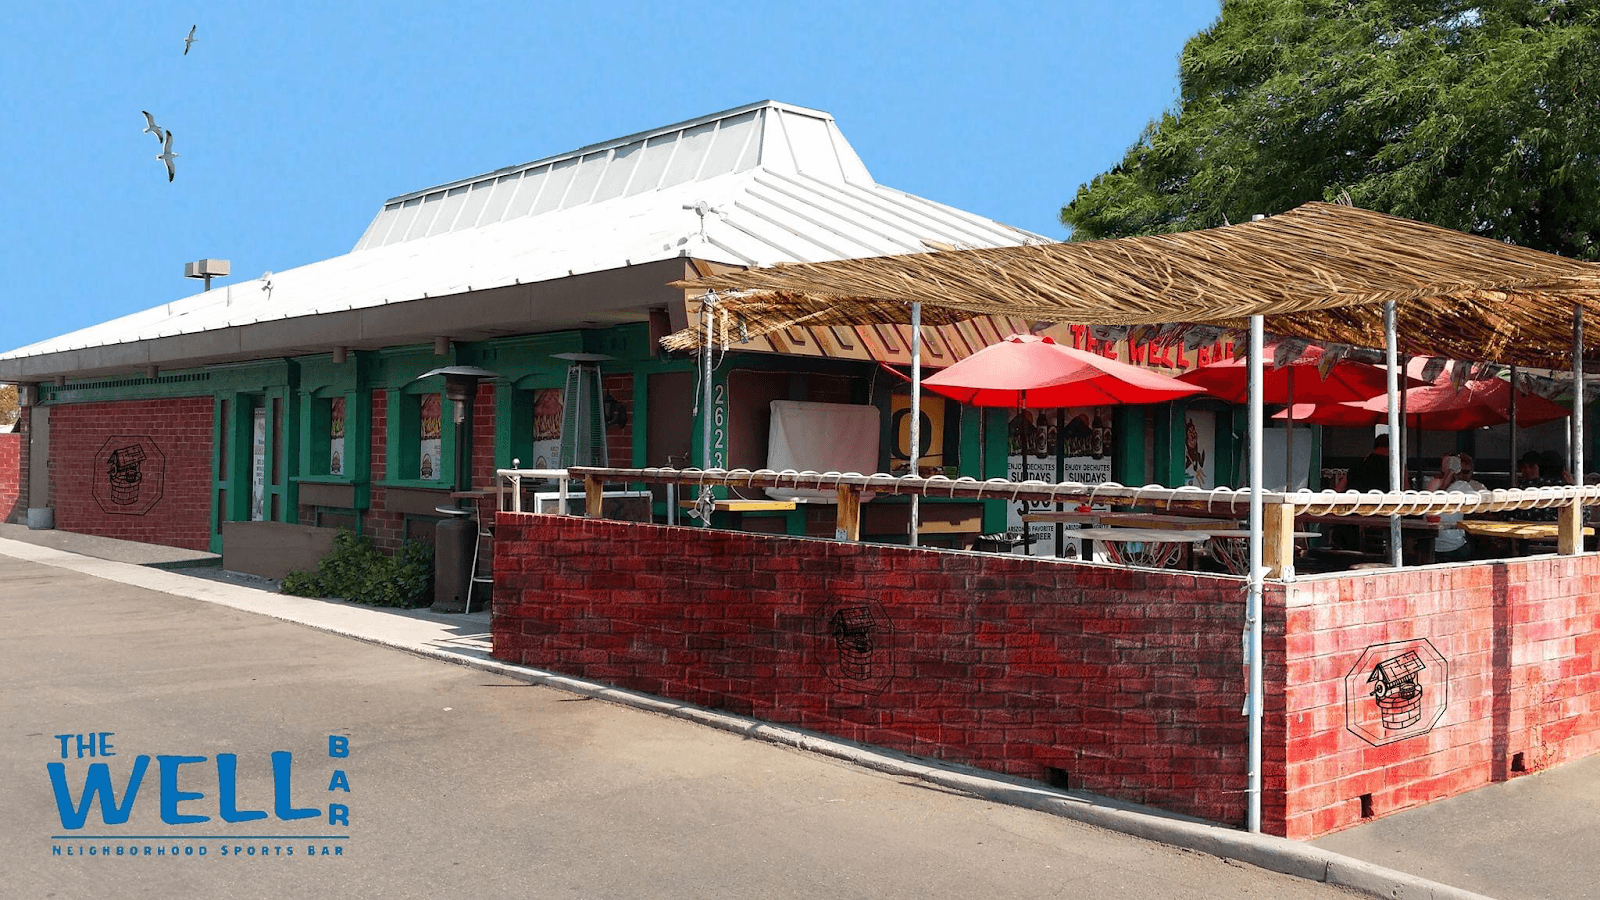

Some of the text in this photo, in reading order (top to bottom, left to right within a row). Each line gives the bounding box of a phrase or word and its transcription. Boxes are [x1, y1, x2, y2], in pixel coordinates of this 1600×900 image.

[714, 384, 724, 469] 2623
[1012, 472, 1051, 483] SUDAYS
[1069, 473, 1106, 482] SUNDAYS
